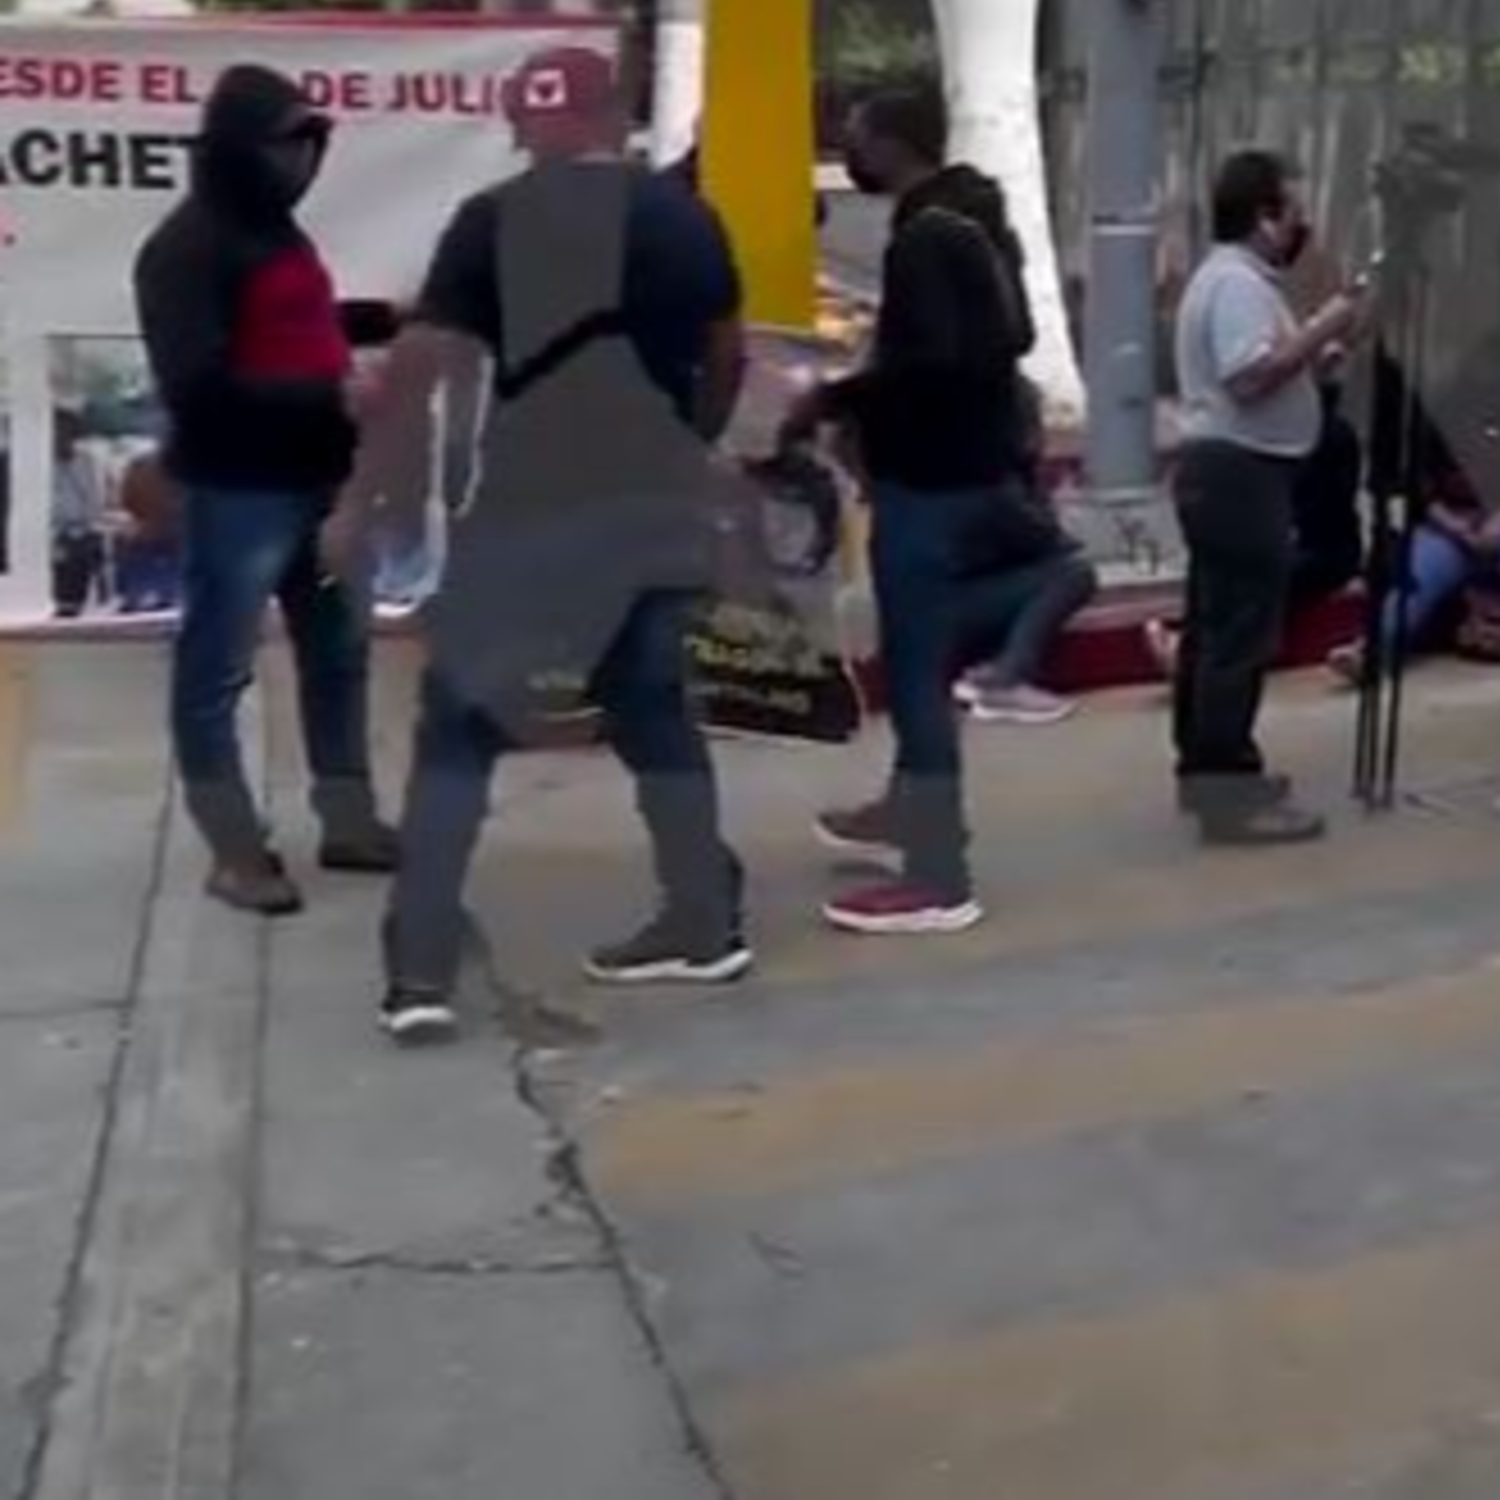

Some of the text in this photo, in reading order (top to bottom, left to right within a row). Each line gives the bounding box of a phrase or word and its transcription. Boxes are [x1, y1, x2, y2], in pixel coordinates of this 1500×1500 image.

[139, 63, 199, 104] EL
[300, 69, 373, 112] DE
[387, 72, 513, 117] JULI
